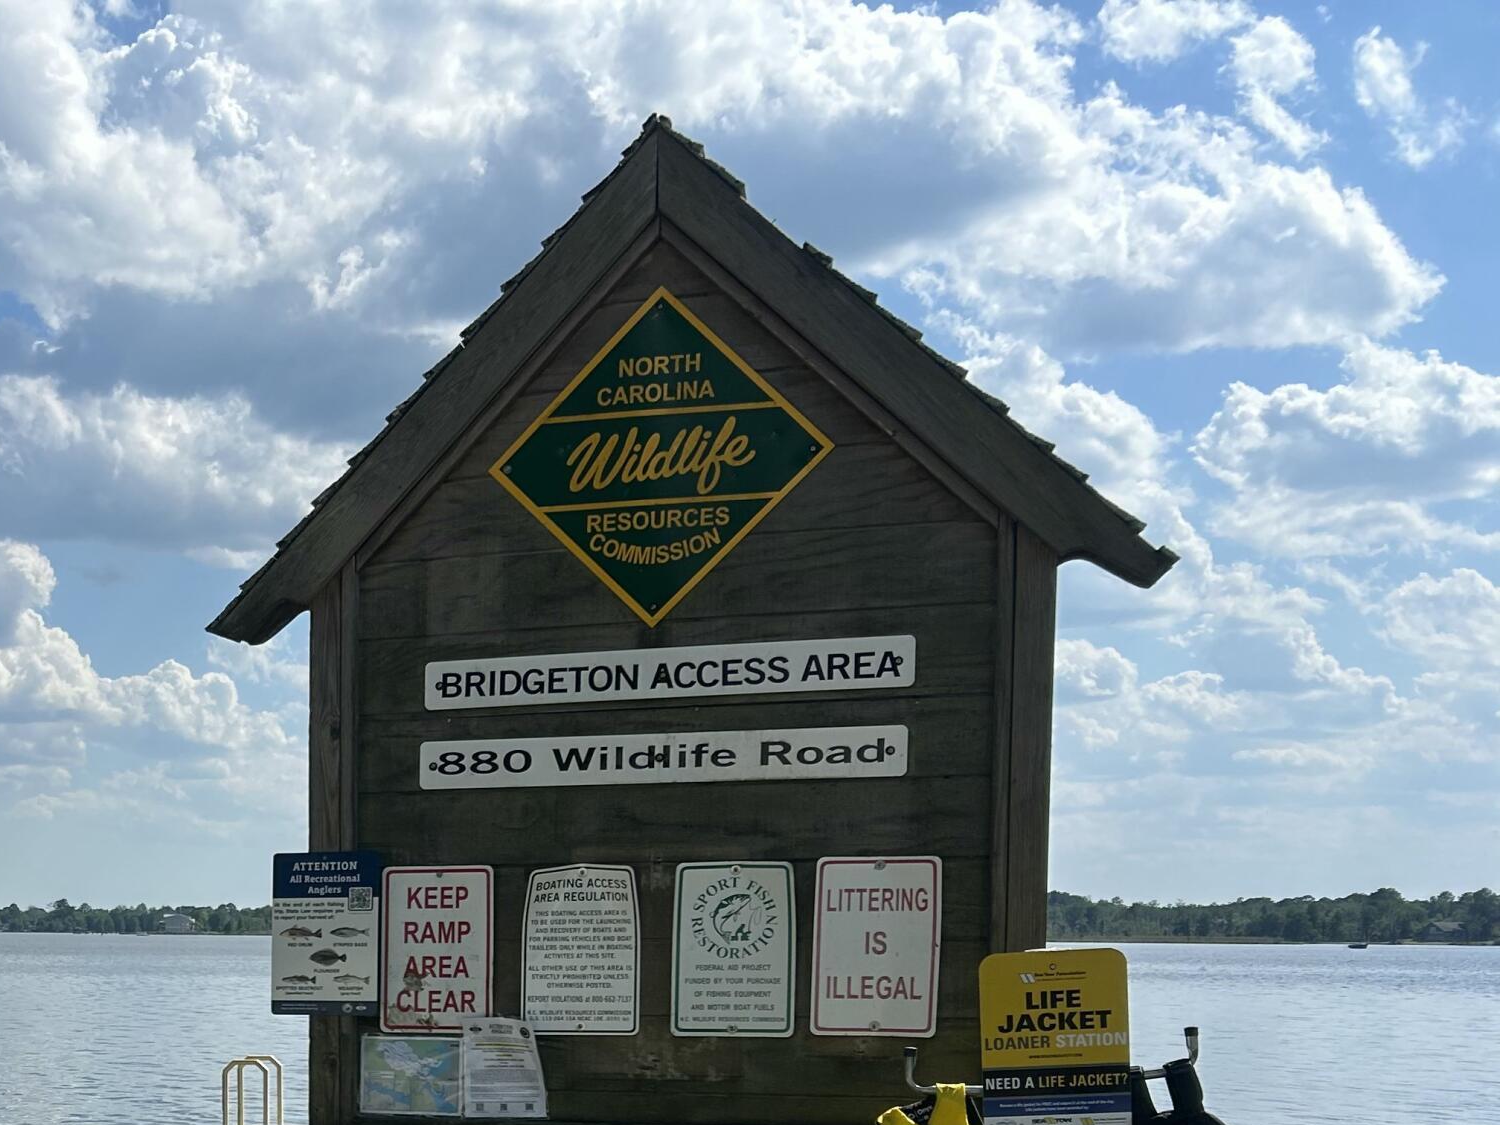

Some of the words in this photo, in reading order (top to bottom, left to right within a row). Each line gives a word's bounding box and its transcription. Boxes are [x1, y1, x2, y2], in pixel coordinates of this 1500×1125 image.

[618, 352, 701, 378] NORTH
[597, 379, 715, 407] CAROLINA
[566, 416, 756, 495] Wildlife
[586, 506, 730, 533] RESOURCES
[589, 527, 721, 565] COMMISSION
[441, 664, 639, 699] BRIDGETON
[651, 656, 790, 690] ACCESS
[800, 651, 902, 682] AREA
[438, 749, 532, 775] 880
[552, 744, 737, 772] Wildlife
[759, 738, 887, 766] Road
[293, 861, 358, 871] ATTENTION
[290, 875, 302, 883] All
[304, 874, 360, 883] Recreational
[308, 885, 341, 895] Anglers
[536, 878, 583, 891] BOATING
[587, 879, 627, 889] ACCESS
[407, 886, 468, 909] KEEP
[534, 893, 560, 903] AREA
[564, 892, 628, 901] REGULATION
[693, 877, 740, 912] SPORT
[746, 880, 776, 911] FISH
[826, 888, 928, 912] LITTERING
[404, 922, 470, 944] RAMP
[692, 914, 779, 959] RESTORATION
[865, 931, 887, 955] IS
[404, 956, 469, 978] AREA
[826, 976, 922, 1000] ILLEGAL
[1025, 989, 1081, 1010] LIFE
[396, 990, 476, 1012] CLEAR
[998, 1010, 1112, 1033] JACKET
[985, 1036, 1050, 1050] LOANER
[1055, 1032, 1128, 1048] STATION
[985, 1078, 1020, 1090] NEED
[1025, 1077, 1035, 1088] A
[1038, 1075, 1065, 1088] LIFE
[1069, 1073, 1128, 1086] JACKET?
